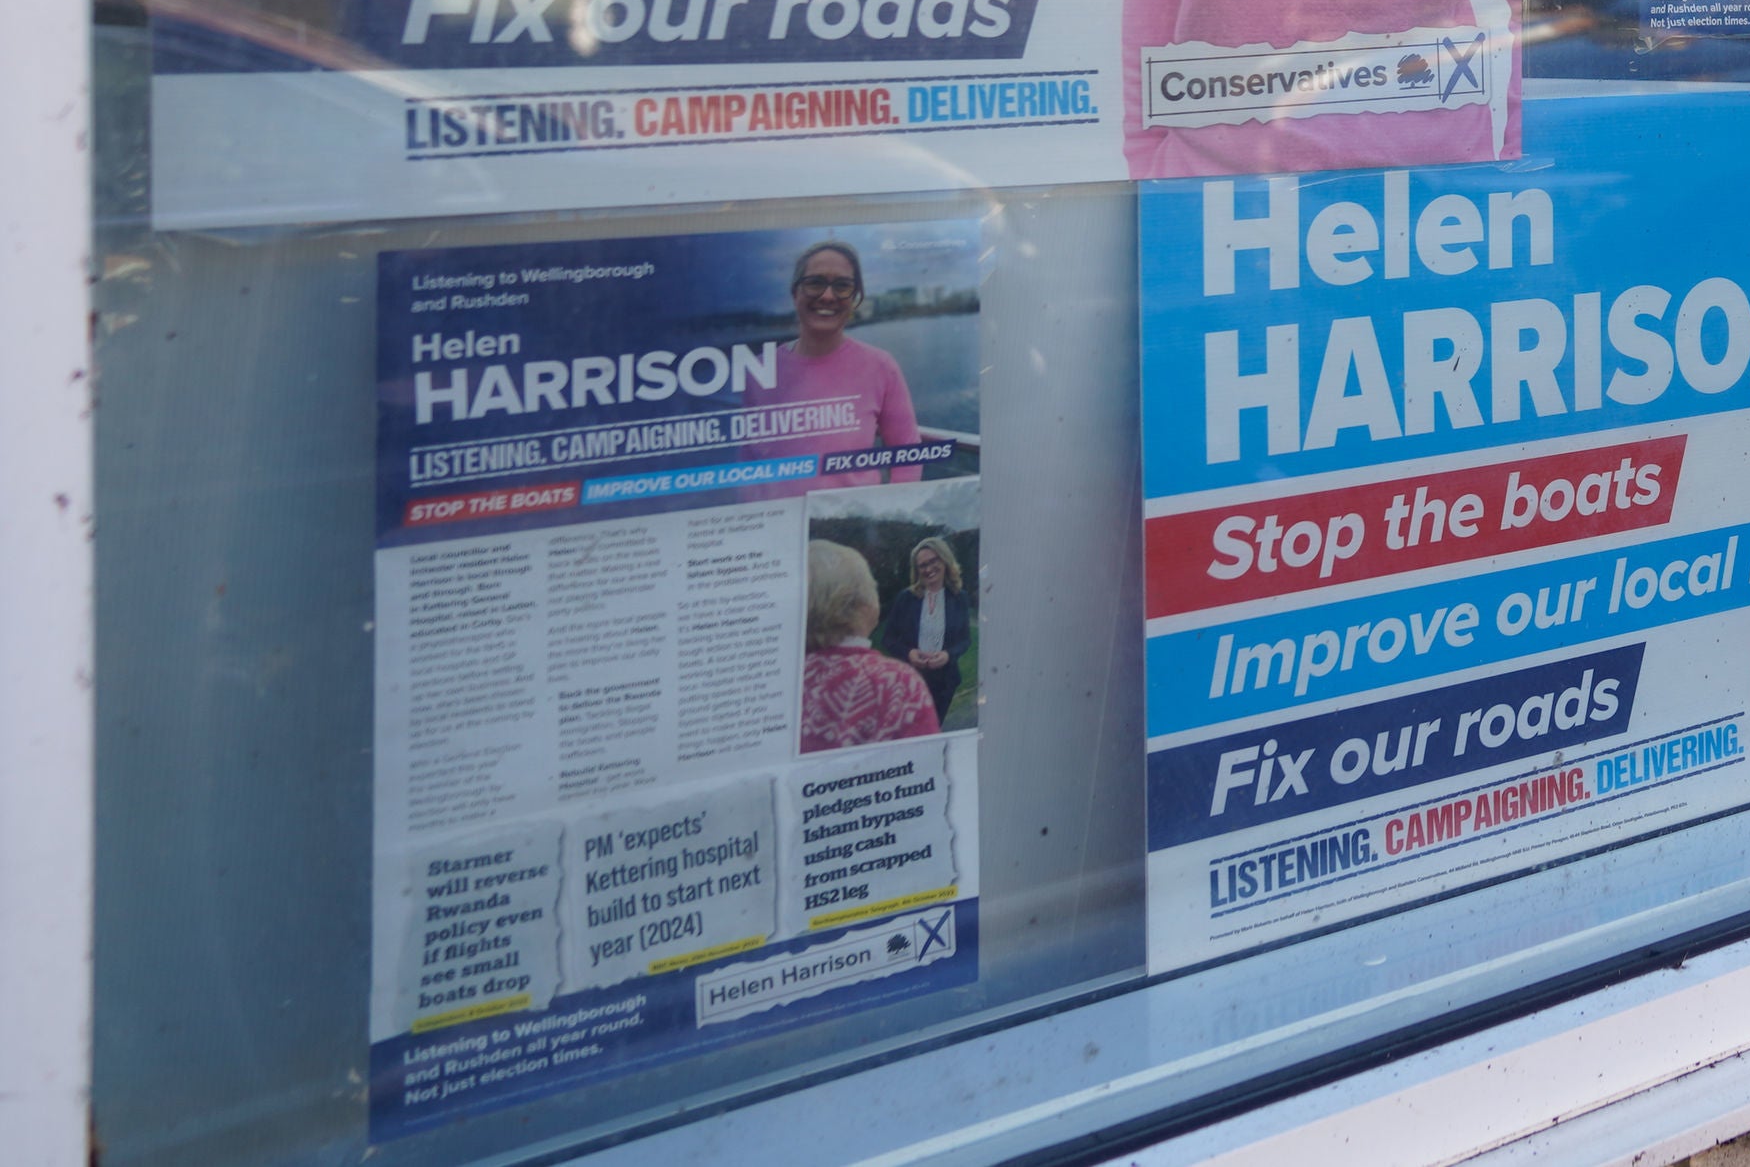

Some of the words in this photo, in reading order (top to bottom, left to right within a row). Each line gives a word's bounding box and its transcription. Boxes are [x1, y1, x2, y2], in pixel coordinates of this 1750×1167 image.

[1650, 4, 1666, 14] and
[1667, 4, 1708, 14] Rushden
[1710, 3, 1720, 12] all
[1723, 5, 1742, 14] year
[1650, 18, 1666, 28] Not
[1667, 17, 1685, 29] just
[1688, 16, 1722, 26] election
[1724, 16, 1750, 25] times.
[1160, 60, 1388, 103] Conservatives
[406, 99, 625, 150] LISTENING.
[634, 88, 899, 137] CAMPAIGNING.
[907, 79, 1099, 126] DELIVERING.
[1202, 170, 1555, 297] Helen
[412, 273, 495, 290] Listening
[500, 272, 517, 284] to
[521, 262, 655, 283] Wellingborough
[411, 296, 447, 313] and
[451, 292, 530, 310] Rushden
[412, 330, 521, 363] Helen
[415, 342, 777, 425] HARRISON
[409, 439, 546, 482] LISTENING.
[551, 417, 726, 463] CAMPAIGNING.
[730, 402, 861, 435] DELIVERING.
[825, 456, 853, 472] FIX
[855, 449, 891, 467] OUR
[895, 444, 953, 463] ROADS
[587, 475, 670, 500] IMPROVE
[674, 470, 715, 490] OUR
[718, 464, 775, 484] LOCAL
[777, 459, 815, 477] NHS
[410, 501, 464, 521] STOP
[468, 496, 508, 513] THE
[510, 486, 576, 509] BOATS
[1205, 511, 1365, 582] Stop
[1383, 486, 1484, 553] the
[1502, 456, 1663, 530] boats
[1207, 606, 1475, 700] Improve
[1495, 574, 1599, 636] our
[1607, 539, 1736, 615] local
[1207, 737, 1310, 818] Fix
[1328, 716, 1442, 778] our
[1452, 670, 1622, 758] roads
[802, 760, 914, 798] Government
[803, 796, 872, 824] pledges
[874, 790, 892, 804] to
[894, 777, 935, 800] fund
[1209, 827, 1378, 909] LISTENING.
[1385, 768, 1591, 856] CAMPAIGNING.
[1597, 722, 1745, 796] DELIVERING.
[803, 819, 859, 844] Isham
[861, 805, 924, 830] bypass
[427, 850, 514, 877] Starmer
[584, 833, 614, 862] PM
[586, 857, 679, 895] Kettering
[682, 830, 759, 871] hospital
[804, 844, 853, 866] using
[855, 832, 896, 853] cash
[804, 865, 852, 889] from
[850, 844, 932, 876] scrapped
[426, 877, 469, 899] will
[474, 864, 549, 890] reverse
[588, 894, 636, 928] build
[641, 892, 662, 914] to
[667, 877, 713, 908] start
[718, 865, 761, 894] next
[804, 889, 839, 911] HS2
[842, 884, 869, 902] leg
[426, 892, 511, 922] Rwanda
[424, 918, 491, 947] policy
[496, 907, 543, 928] even
[590, 934, 634, 967] year
[639, 911, 703, 951] (2024)
[420, 971, 455, 987] see
[460, 951, 520, 978] small
[423, 947, 441, 966] if
[444, 935, 512, 960] flights
[418, 984, 477, 1010] boats
[483, 974, 531, 995] drop
[709, 975, 775, 1006] Helen
[782, 949, 872, 985] Harrison
